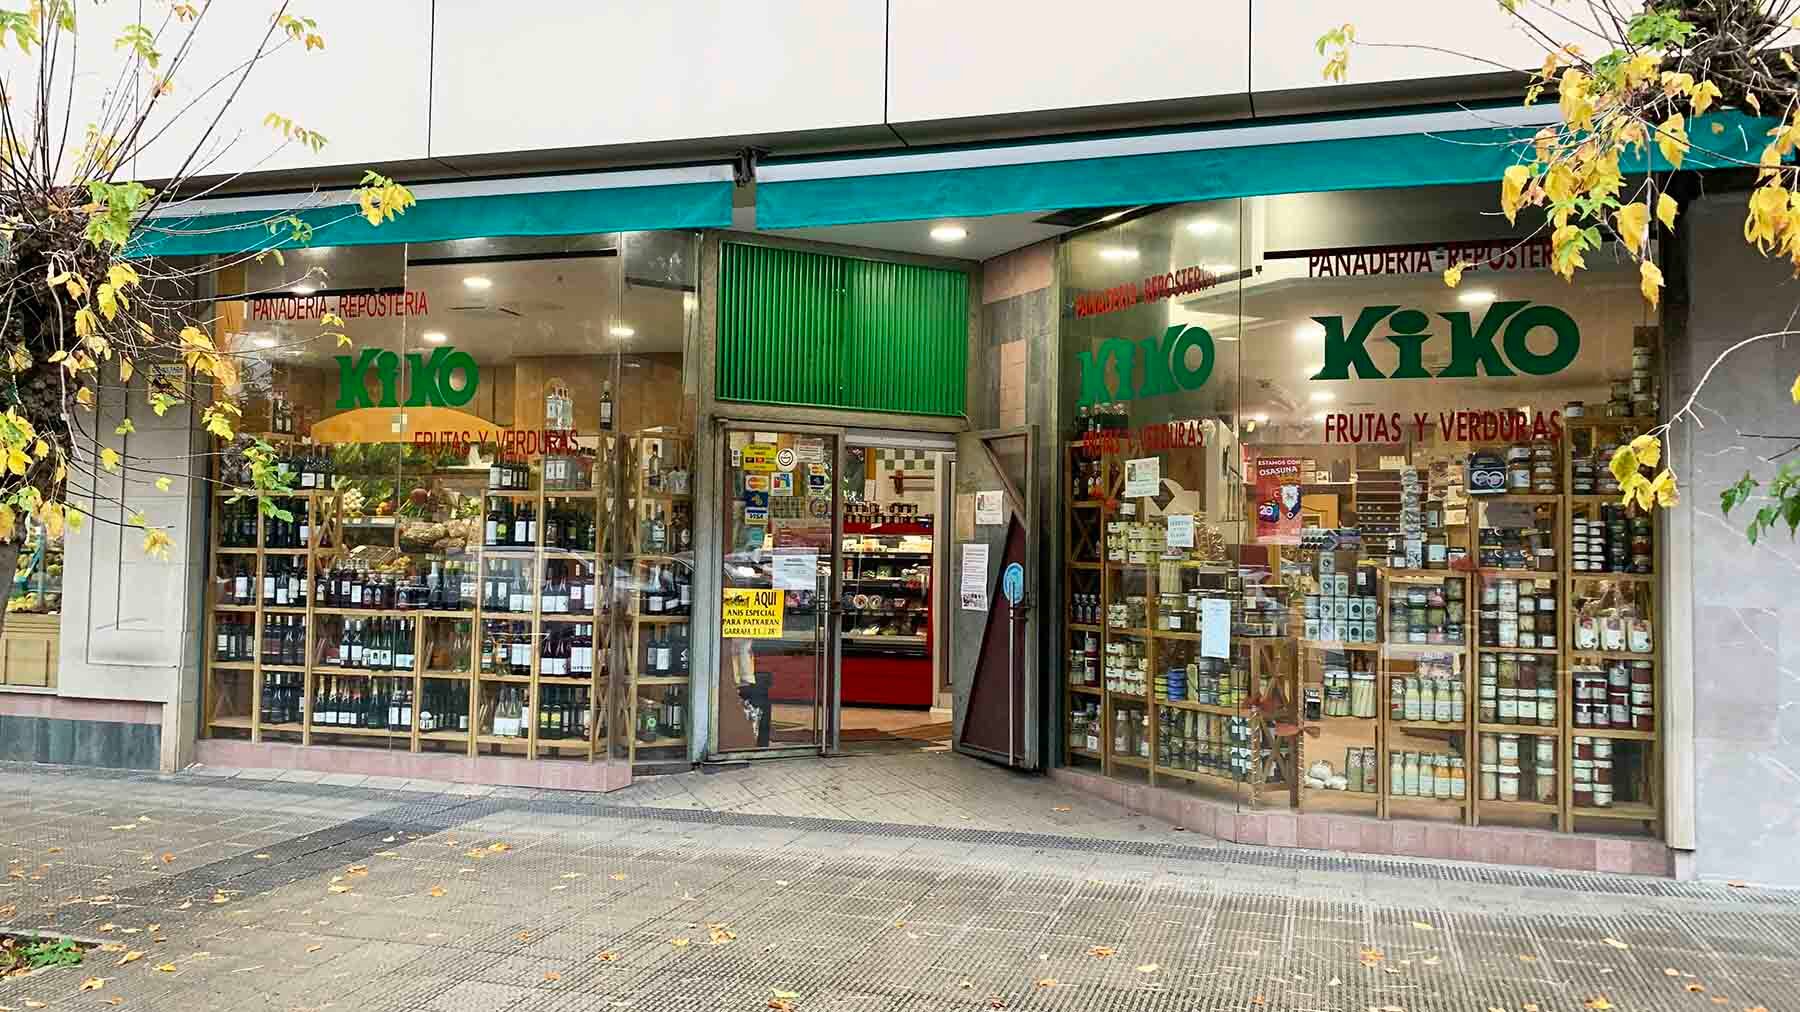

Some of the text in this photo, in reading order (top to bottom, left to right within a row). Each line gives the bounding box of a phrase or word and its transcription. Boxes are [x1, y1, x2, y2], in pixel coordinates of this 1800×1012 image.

[1309, 247, 1432, 278] PANADERIA
[1449, 239, 1552, 273] REPOSTER
[253, 296, 327, 320] PANADERIA
[339, 292, 428, 318] REPOSTERIA
[1325, 409, 1564, 443] FRUTAS Y VERDURAS
[414, 429, 579, 456] FRUTAS Y VERDURAS
[1259, 466, 1298, 477] OSASUNA
[727, 609, 776, 617] ANIS ESPECIAL
[754, 591, 777, 608] AQUI
